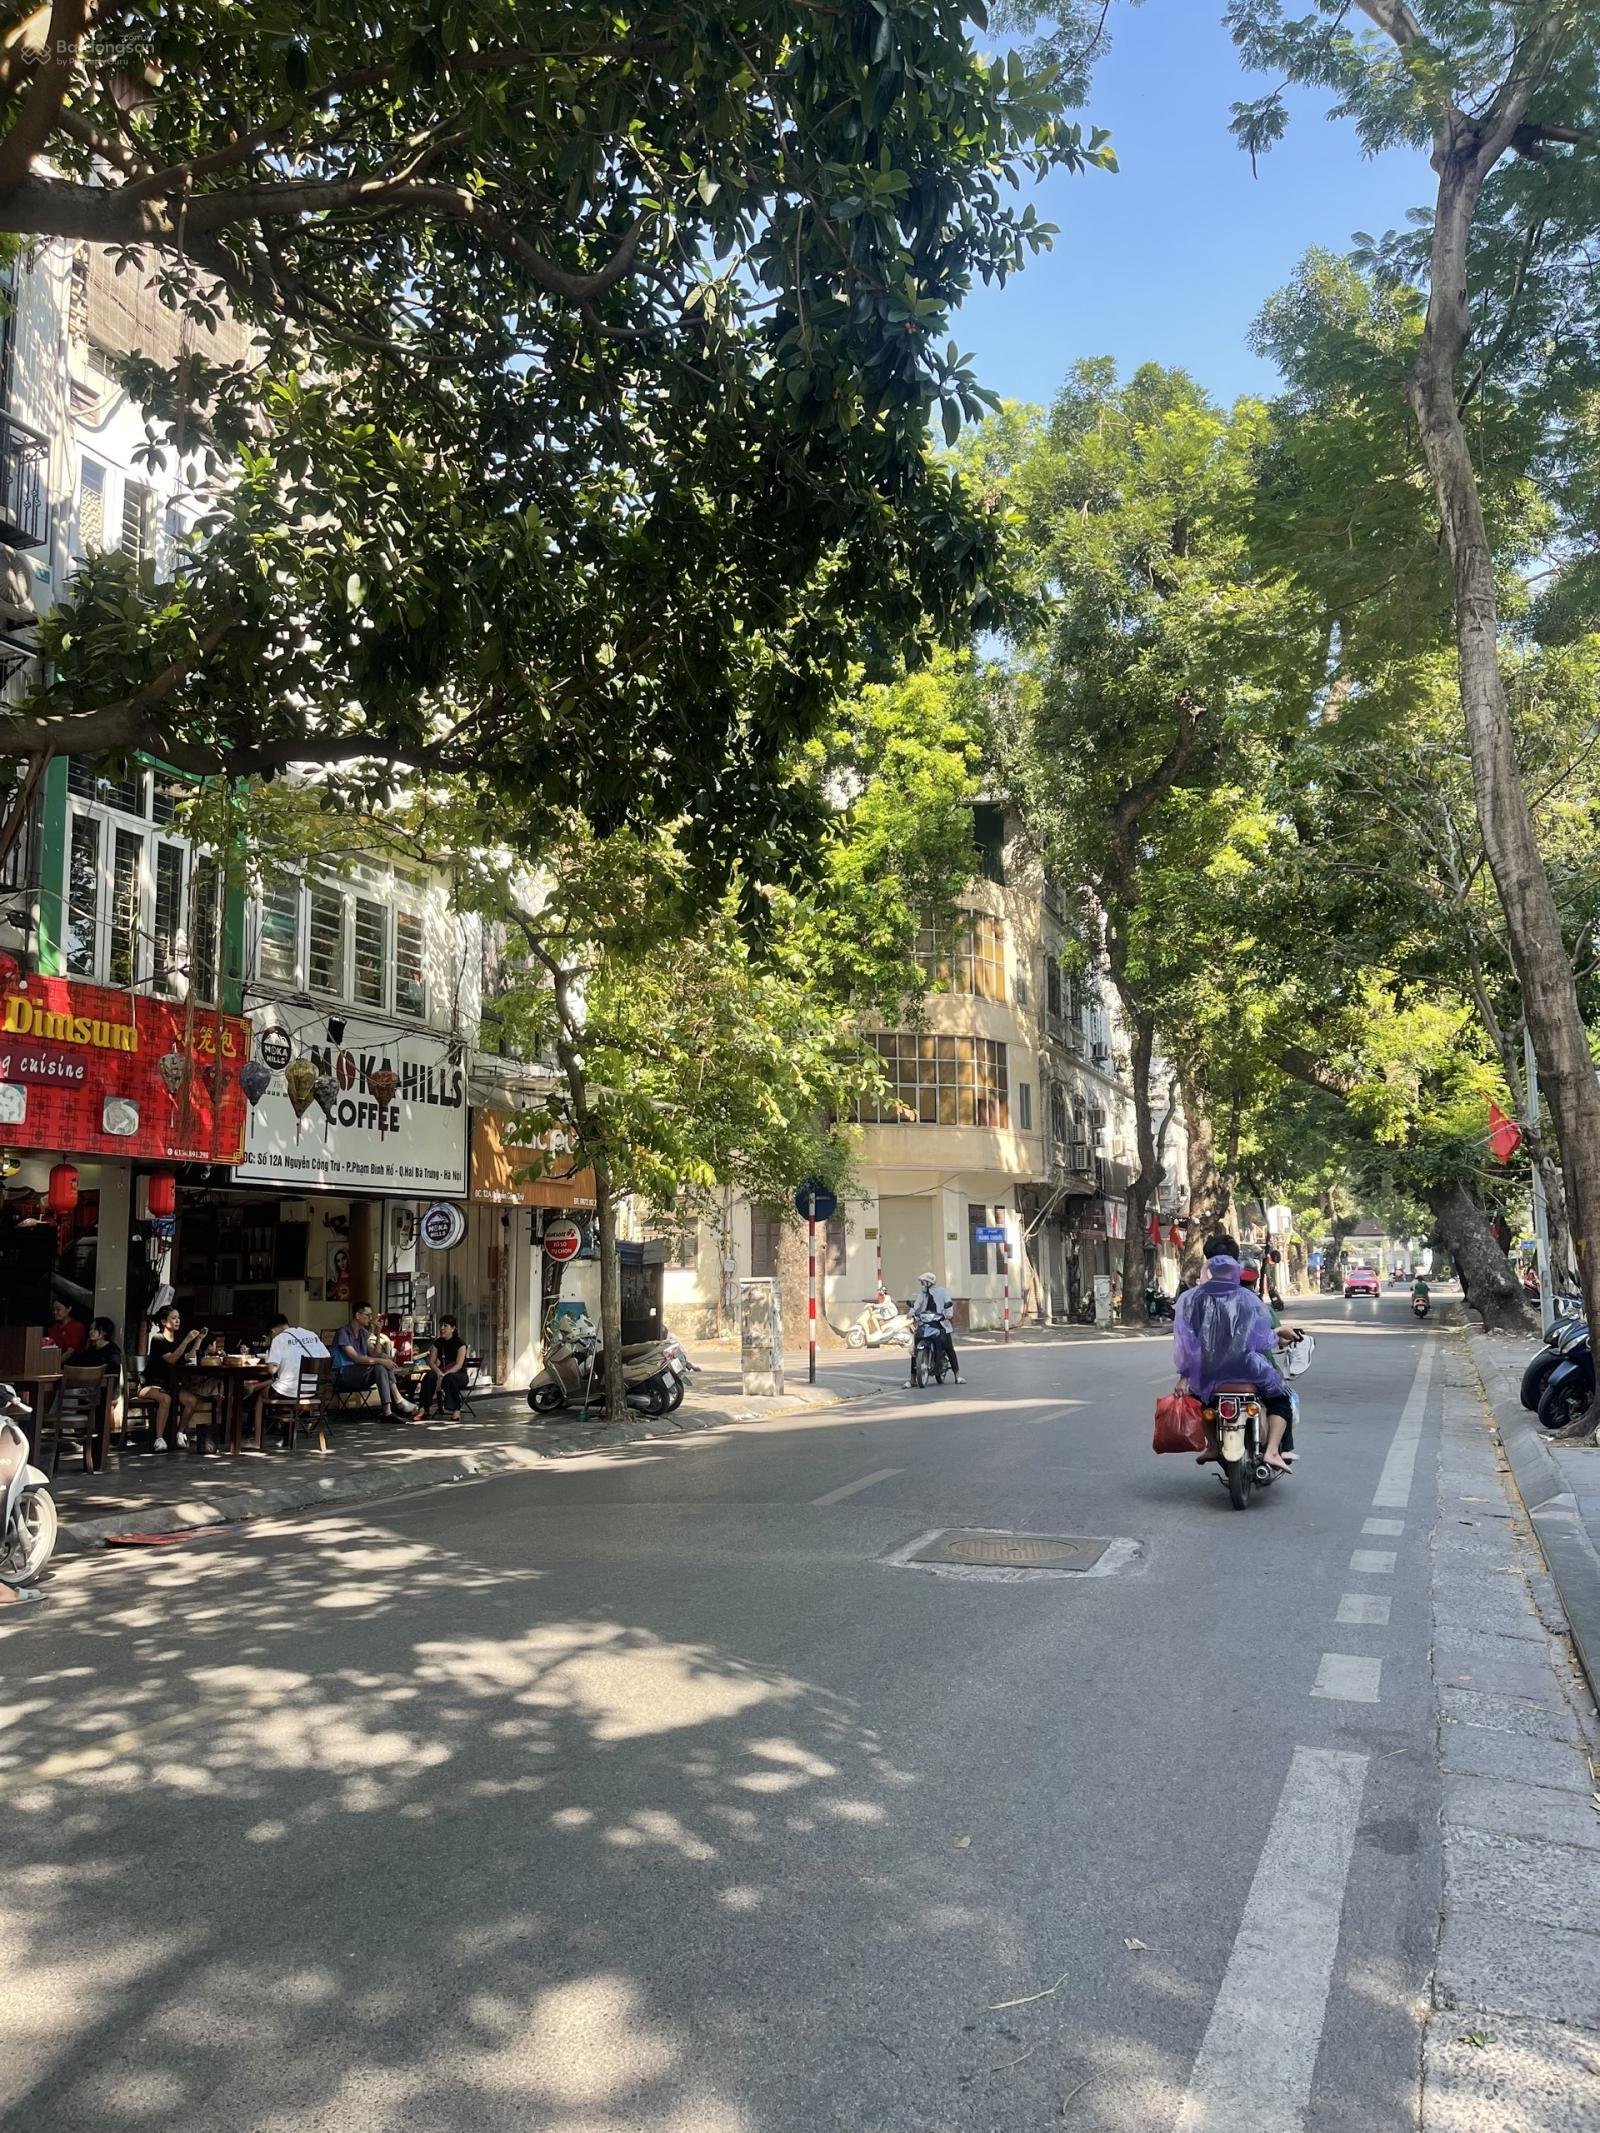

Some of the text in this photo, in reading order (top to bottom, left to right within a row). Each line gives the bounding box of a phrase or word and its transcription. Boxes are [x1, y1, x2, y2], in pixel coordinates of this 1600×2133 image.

[2, 996, 138, 1052] Dimsum
[20, 1053, 84, 1079] cuisine
[402, 1061, 462, 1108] HILLS
[325, 1096, 400, 1132] COFFEE
[258, 1152, 267, 1165] Số
[269, 1154, 282, 1167] 12A
